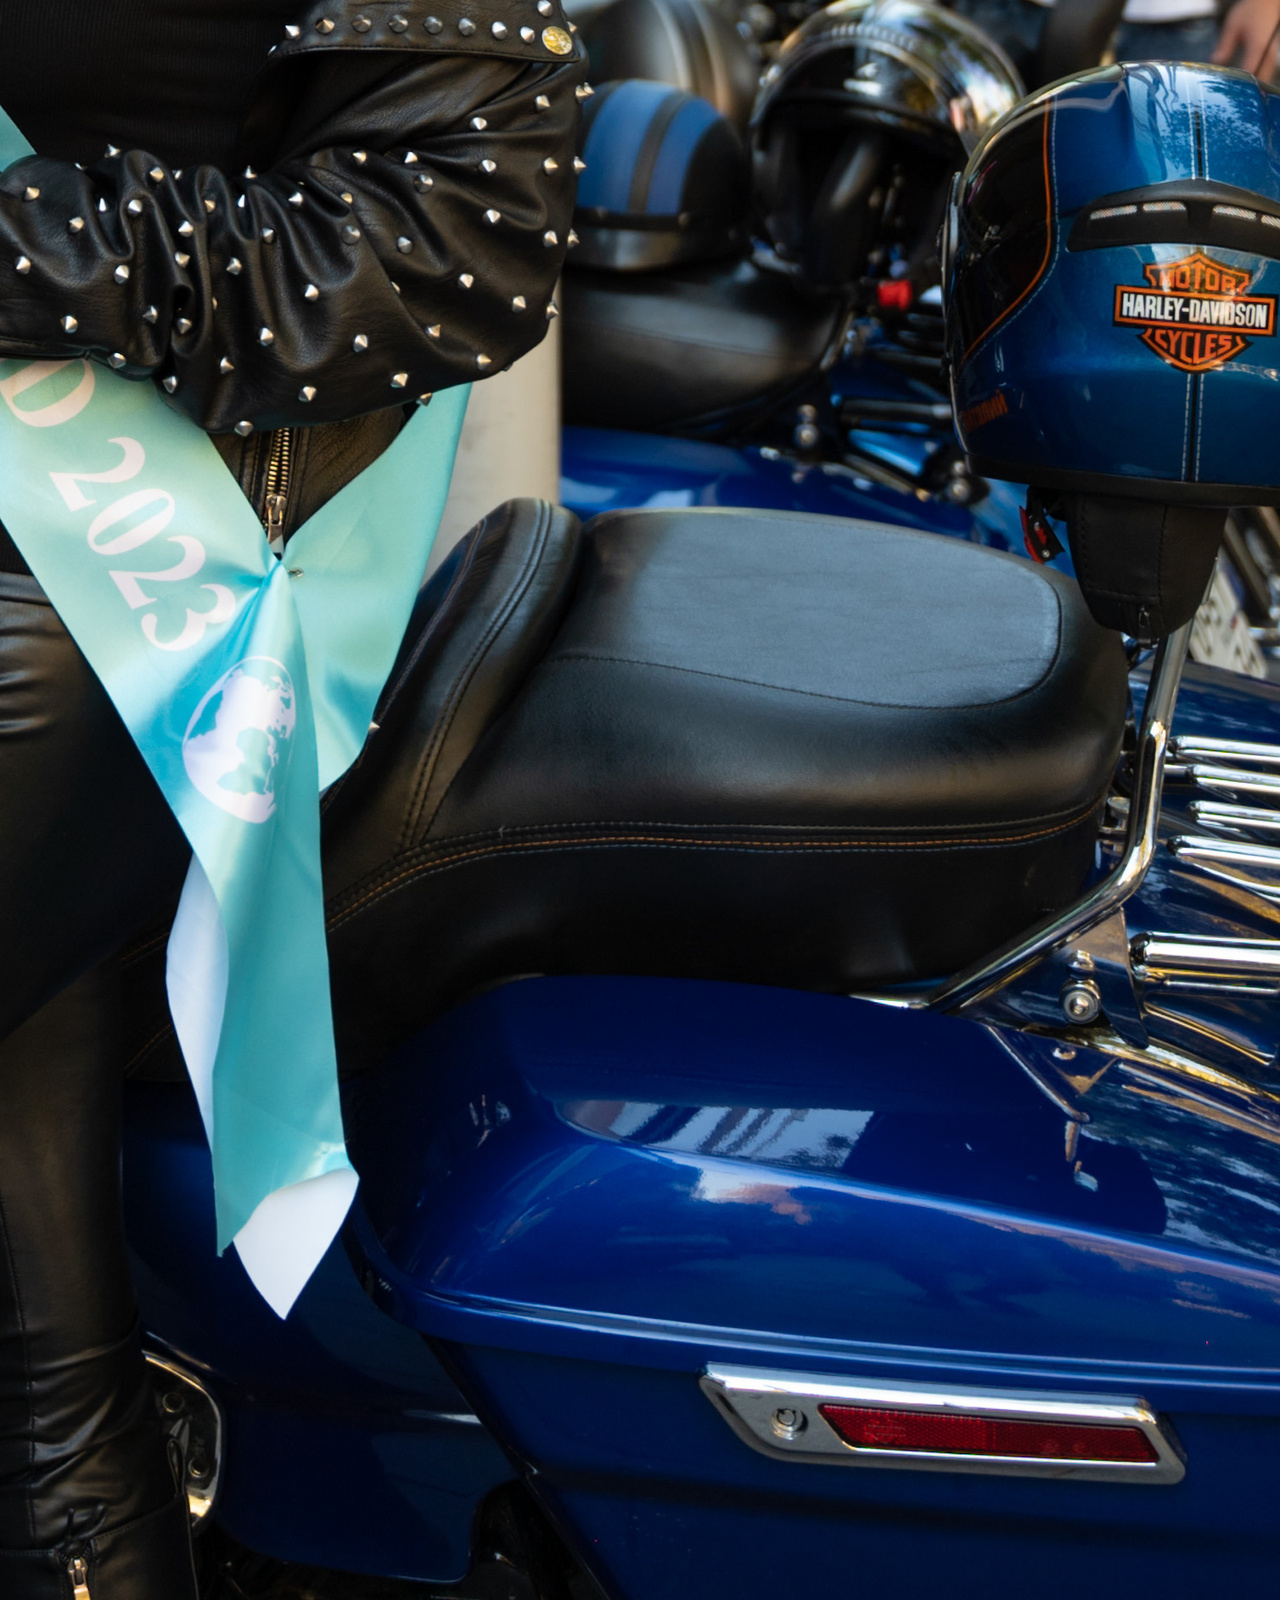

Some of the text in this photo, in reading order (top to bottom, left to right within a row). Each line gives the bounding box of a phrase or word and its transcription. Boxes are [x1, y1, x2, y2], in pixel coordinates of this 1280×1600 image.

[1159, 260, 1238, 293] MOTOR
[1122, 292, 1268, 328] HARLEY-DAVIDSON
[1154, 329, 1233, 365] CYCLES
[48, 436, 237, 652] 2023
